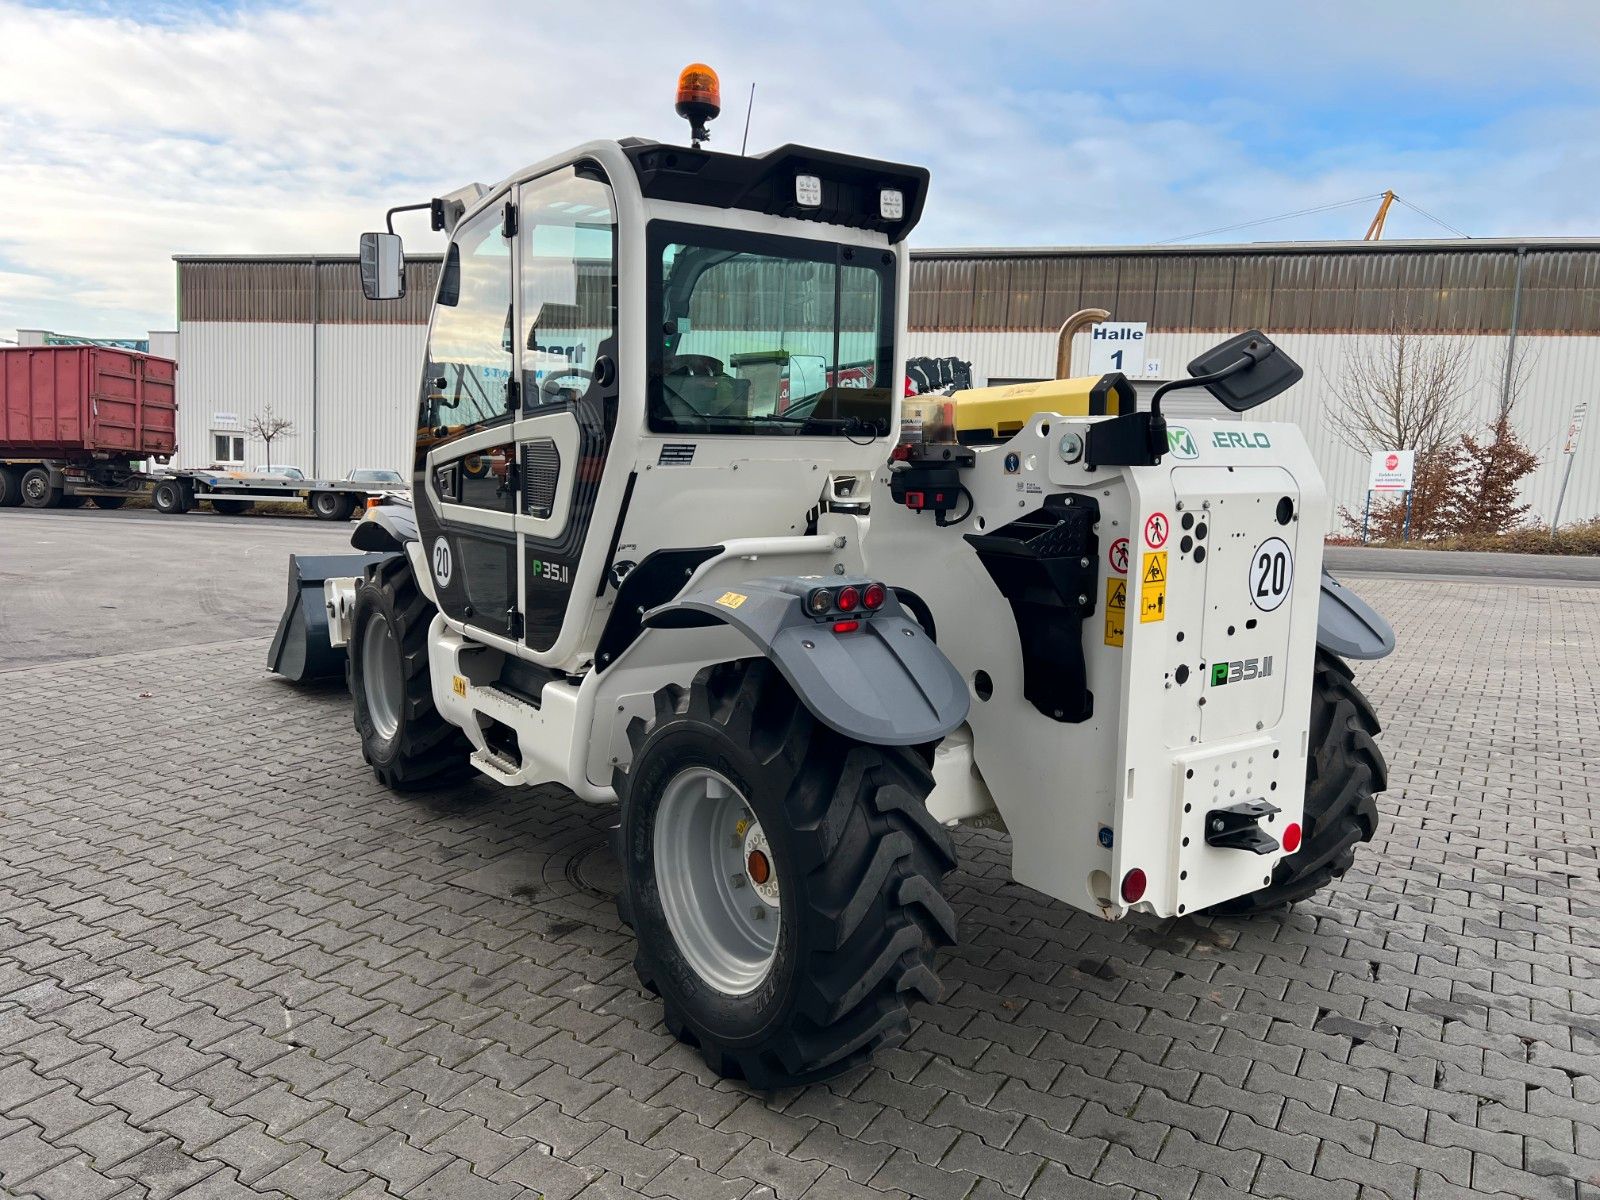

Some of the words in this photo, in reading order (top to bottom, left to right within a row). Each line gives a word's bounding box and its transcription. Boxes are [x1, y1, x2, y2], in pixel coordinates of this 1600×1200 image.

[1093, 327, 1144, 340] Halle
[1110, 349, 1123, 370] 1
[1212, 431, 1271, 448] ERLO
[436, 546, 449, 578] 20
[1256, 551, 1286, 597] 20
